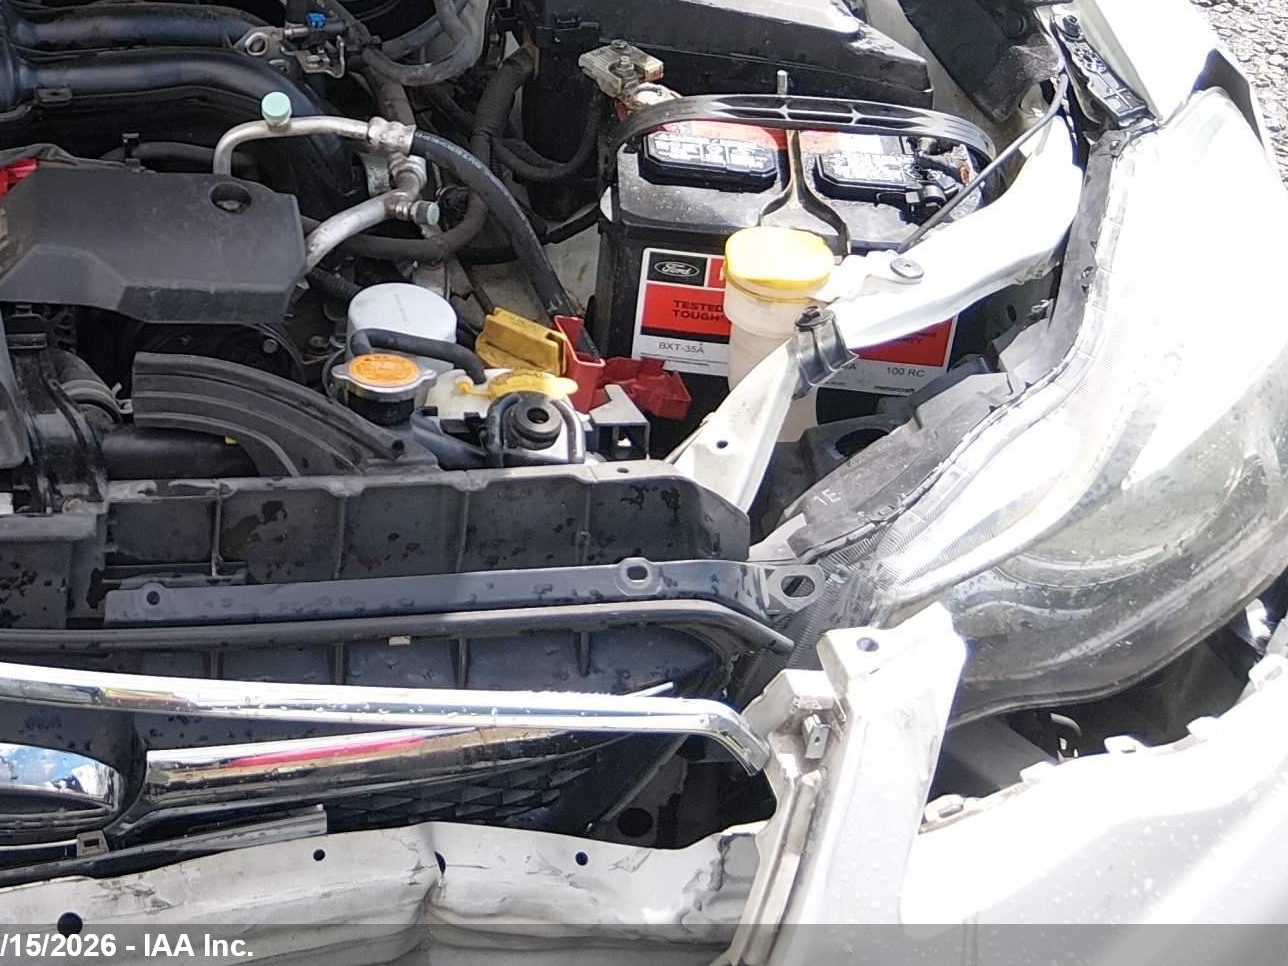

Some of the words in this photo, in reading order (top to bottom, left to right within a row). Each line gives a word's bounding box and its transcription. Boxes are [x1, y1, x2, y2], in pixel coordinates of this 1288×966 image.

[661, 262, 693, 276] Ford
[673, 299, 724, 313] TESTED
[887, 366, 906, 376] 100
[907, 368, 926, 378] RC
